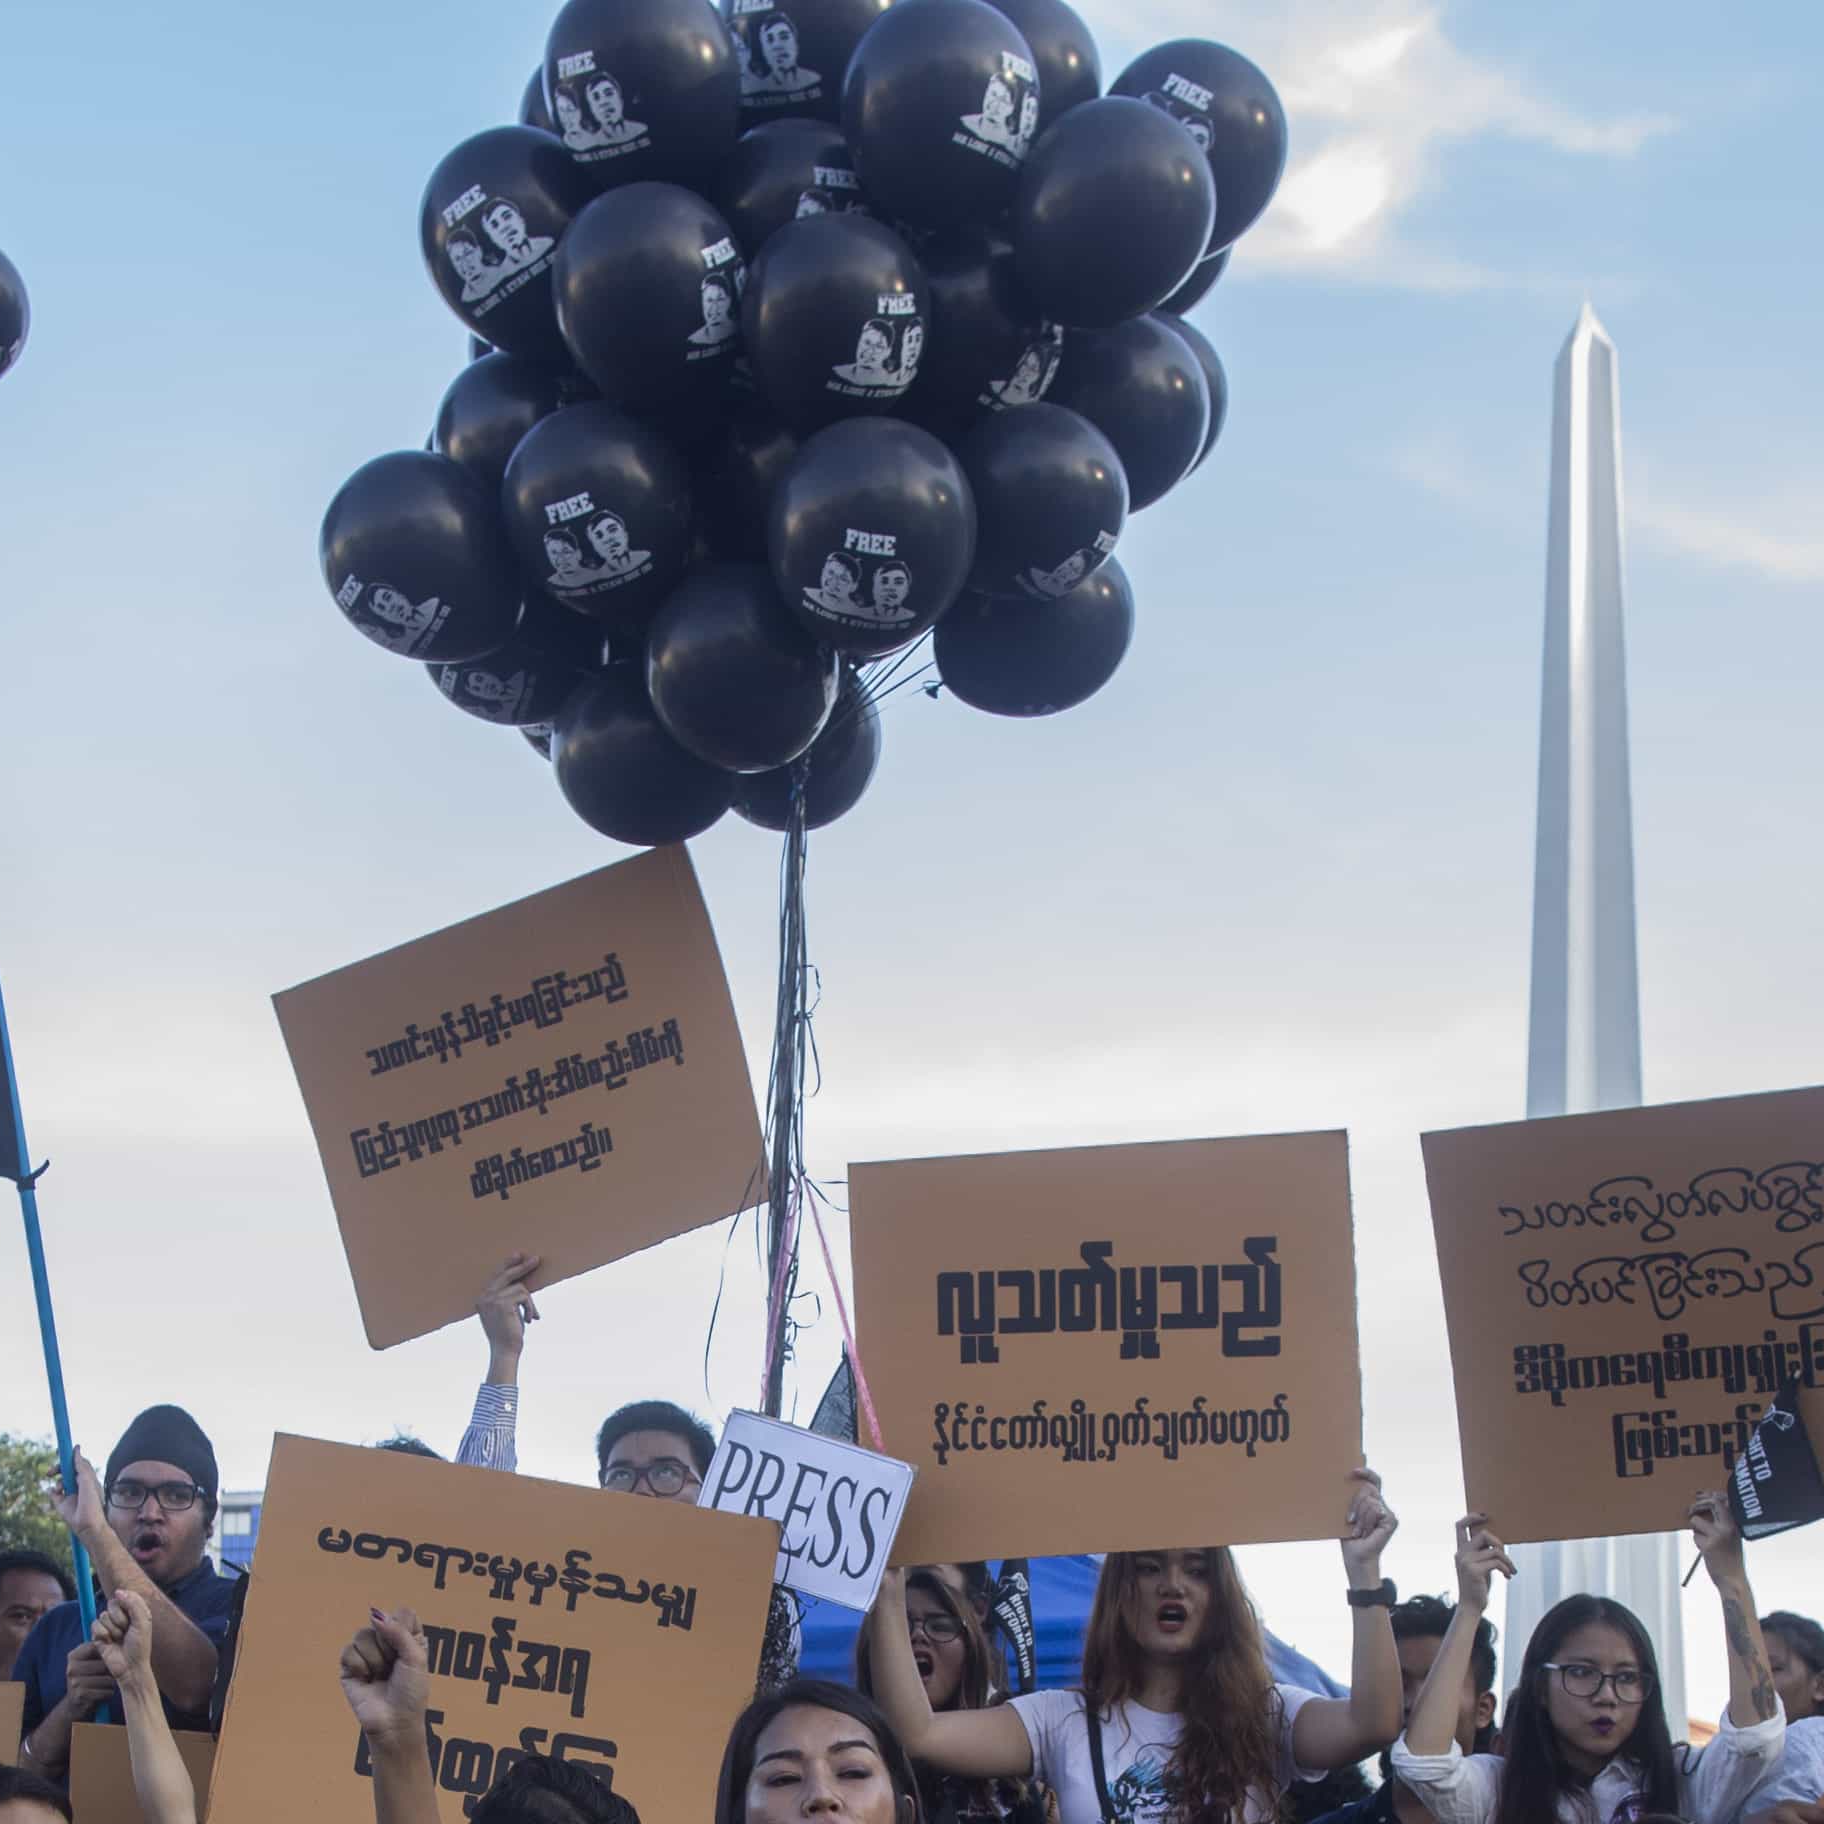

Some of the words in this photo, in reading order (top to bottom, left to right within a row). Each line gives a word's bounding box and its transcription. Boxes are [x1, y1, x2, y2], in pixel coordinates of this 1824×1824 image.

[557, 50, 596, 80] FREE
[1161, 72, 1214, 112] FREE
[442, 184, 488, 229] FREE
[877, 292, 916, 315] FREE
[543, 491, 595, 525] FREE
[843, 527, 896, 557] FREE
[1753, 1460, 1773, 1482] TO
[711, 1439, 893, 1579] PRESS
